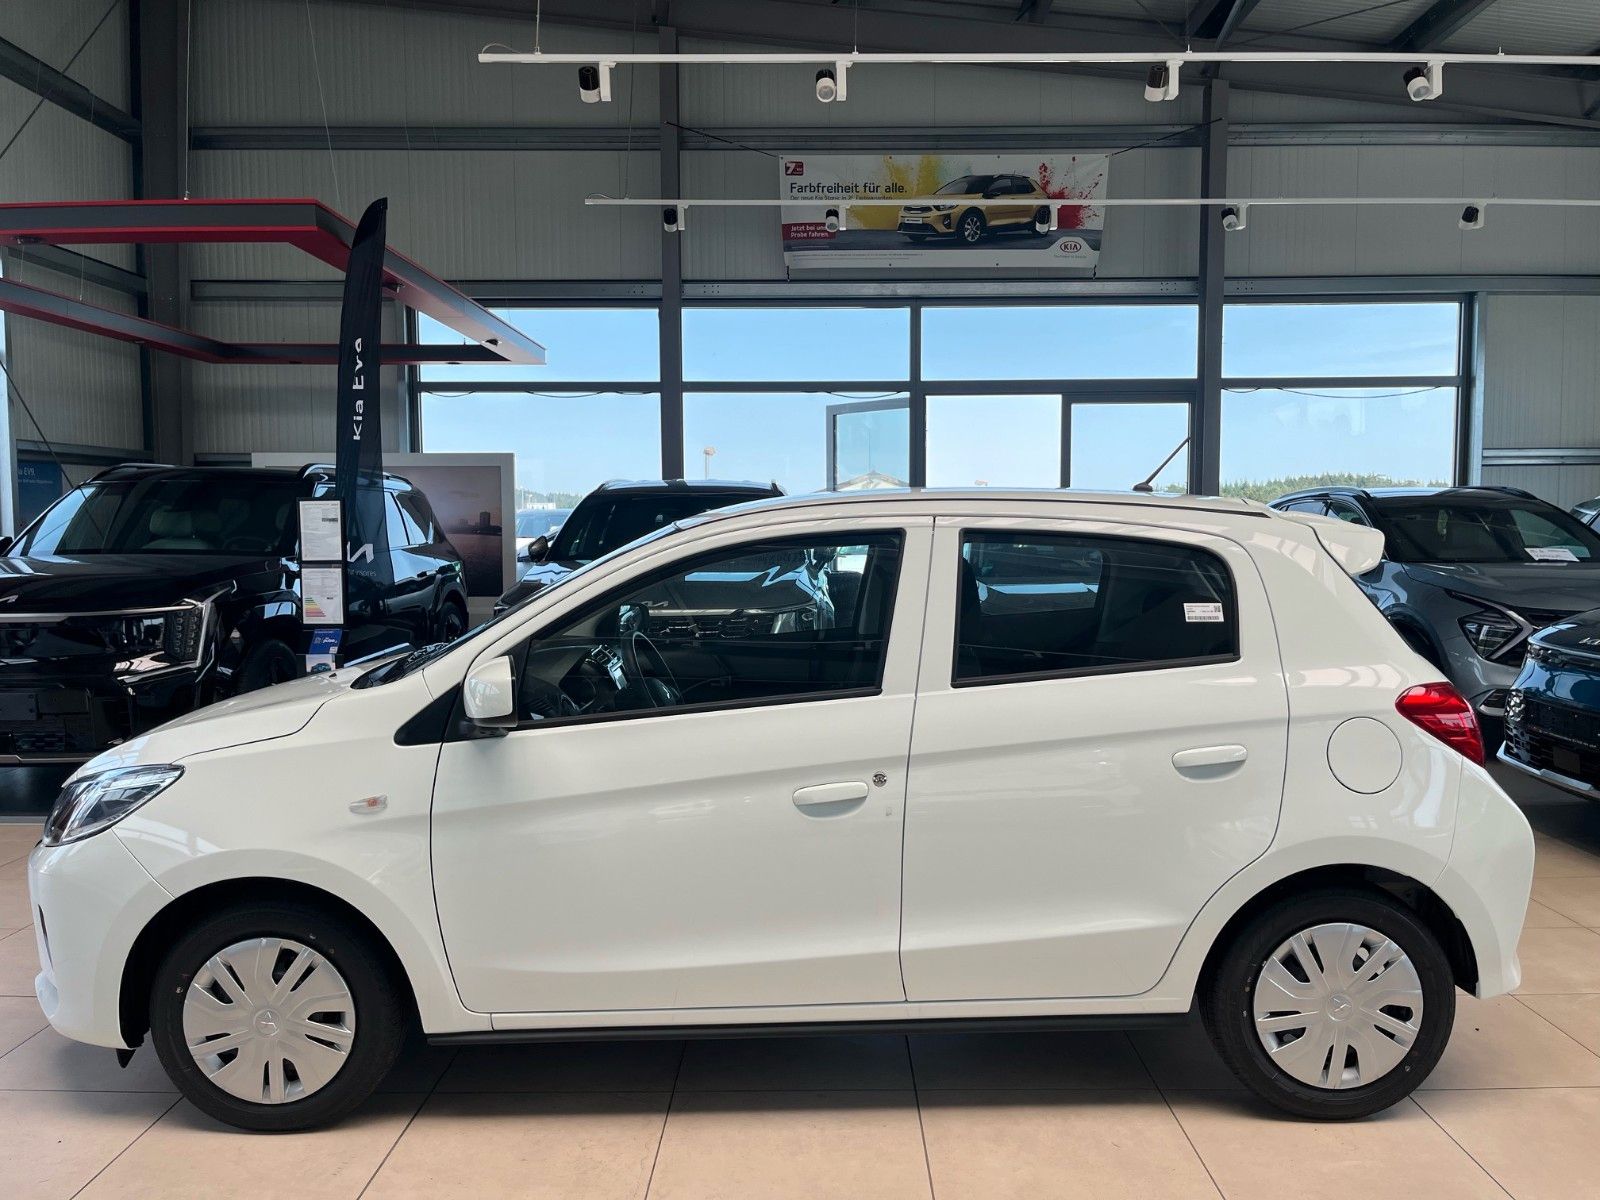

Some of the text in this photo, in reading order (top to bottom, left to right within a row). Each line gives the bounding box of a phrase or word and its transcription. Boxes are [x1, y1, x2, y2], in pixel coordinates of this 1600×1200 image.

[790, 182, 908, 193] Farbfreiheit für alle.
[353, 400, 364, 440] Kia
